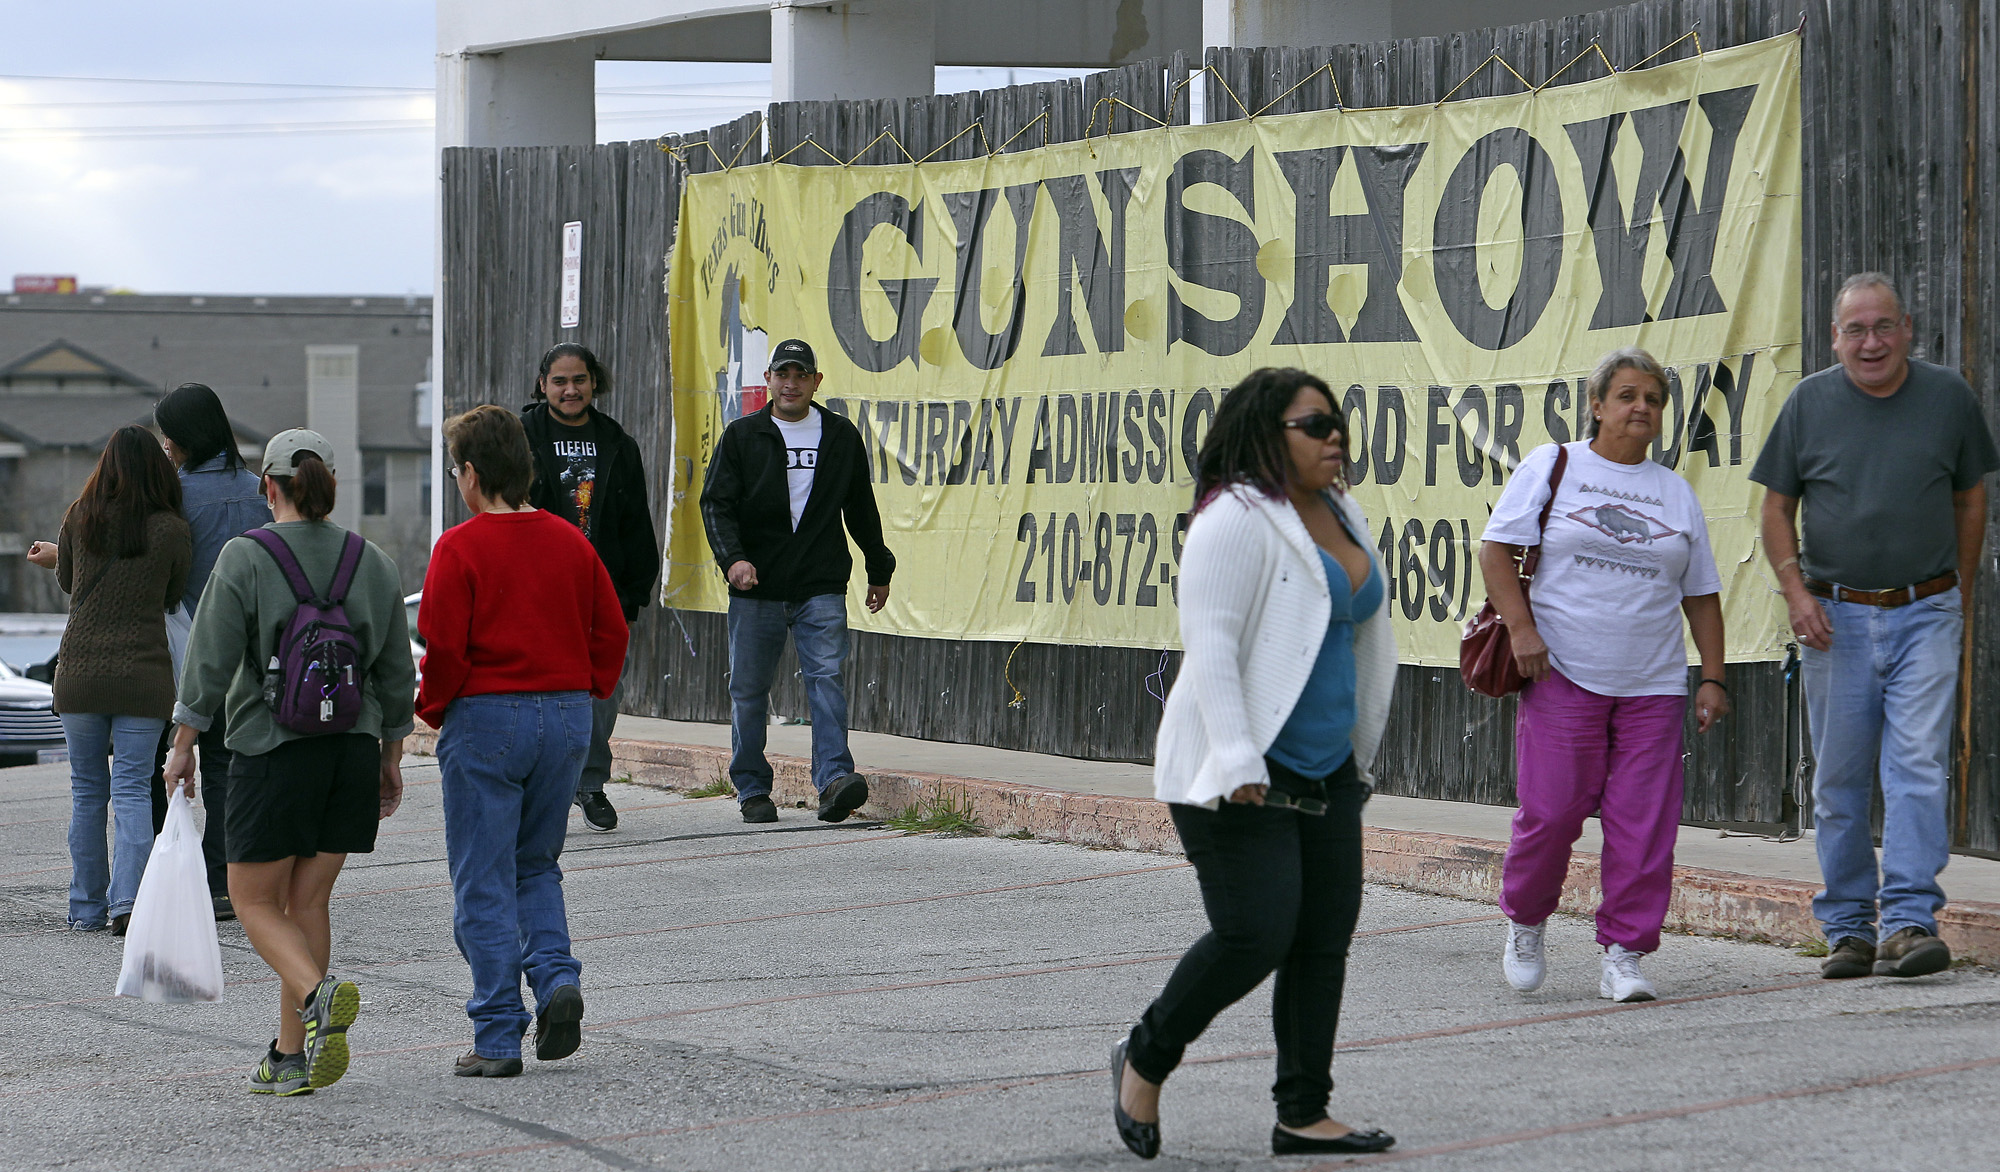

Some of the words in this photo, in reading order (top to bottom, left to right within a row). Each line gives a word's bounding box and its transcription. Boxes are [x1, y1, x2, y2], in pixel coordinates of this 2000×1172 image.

[700, 216, 728, 300] Texas
[730, 192, 746, 238] Gun
[1026, 386, 1231, 485] ADMISSIO
[1425, 383, 1525, 488] FOR
[1543, 352, 1756, 472] SDAY
